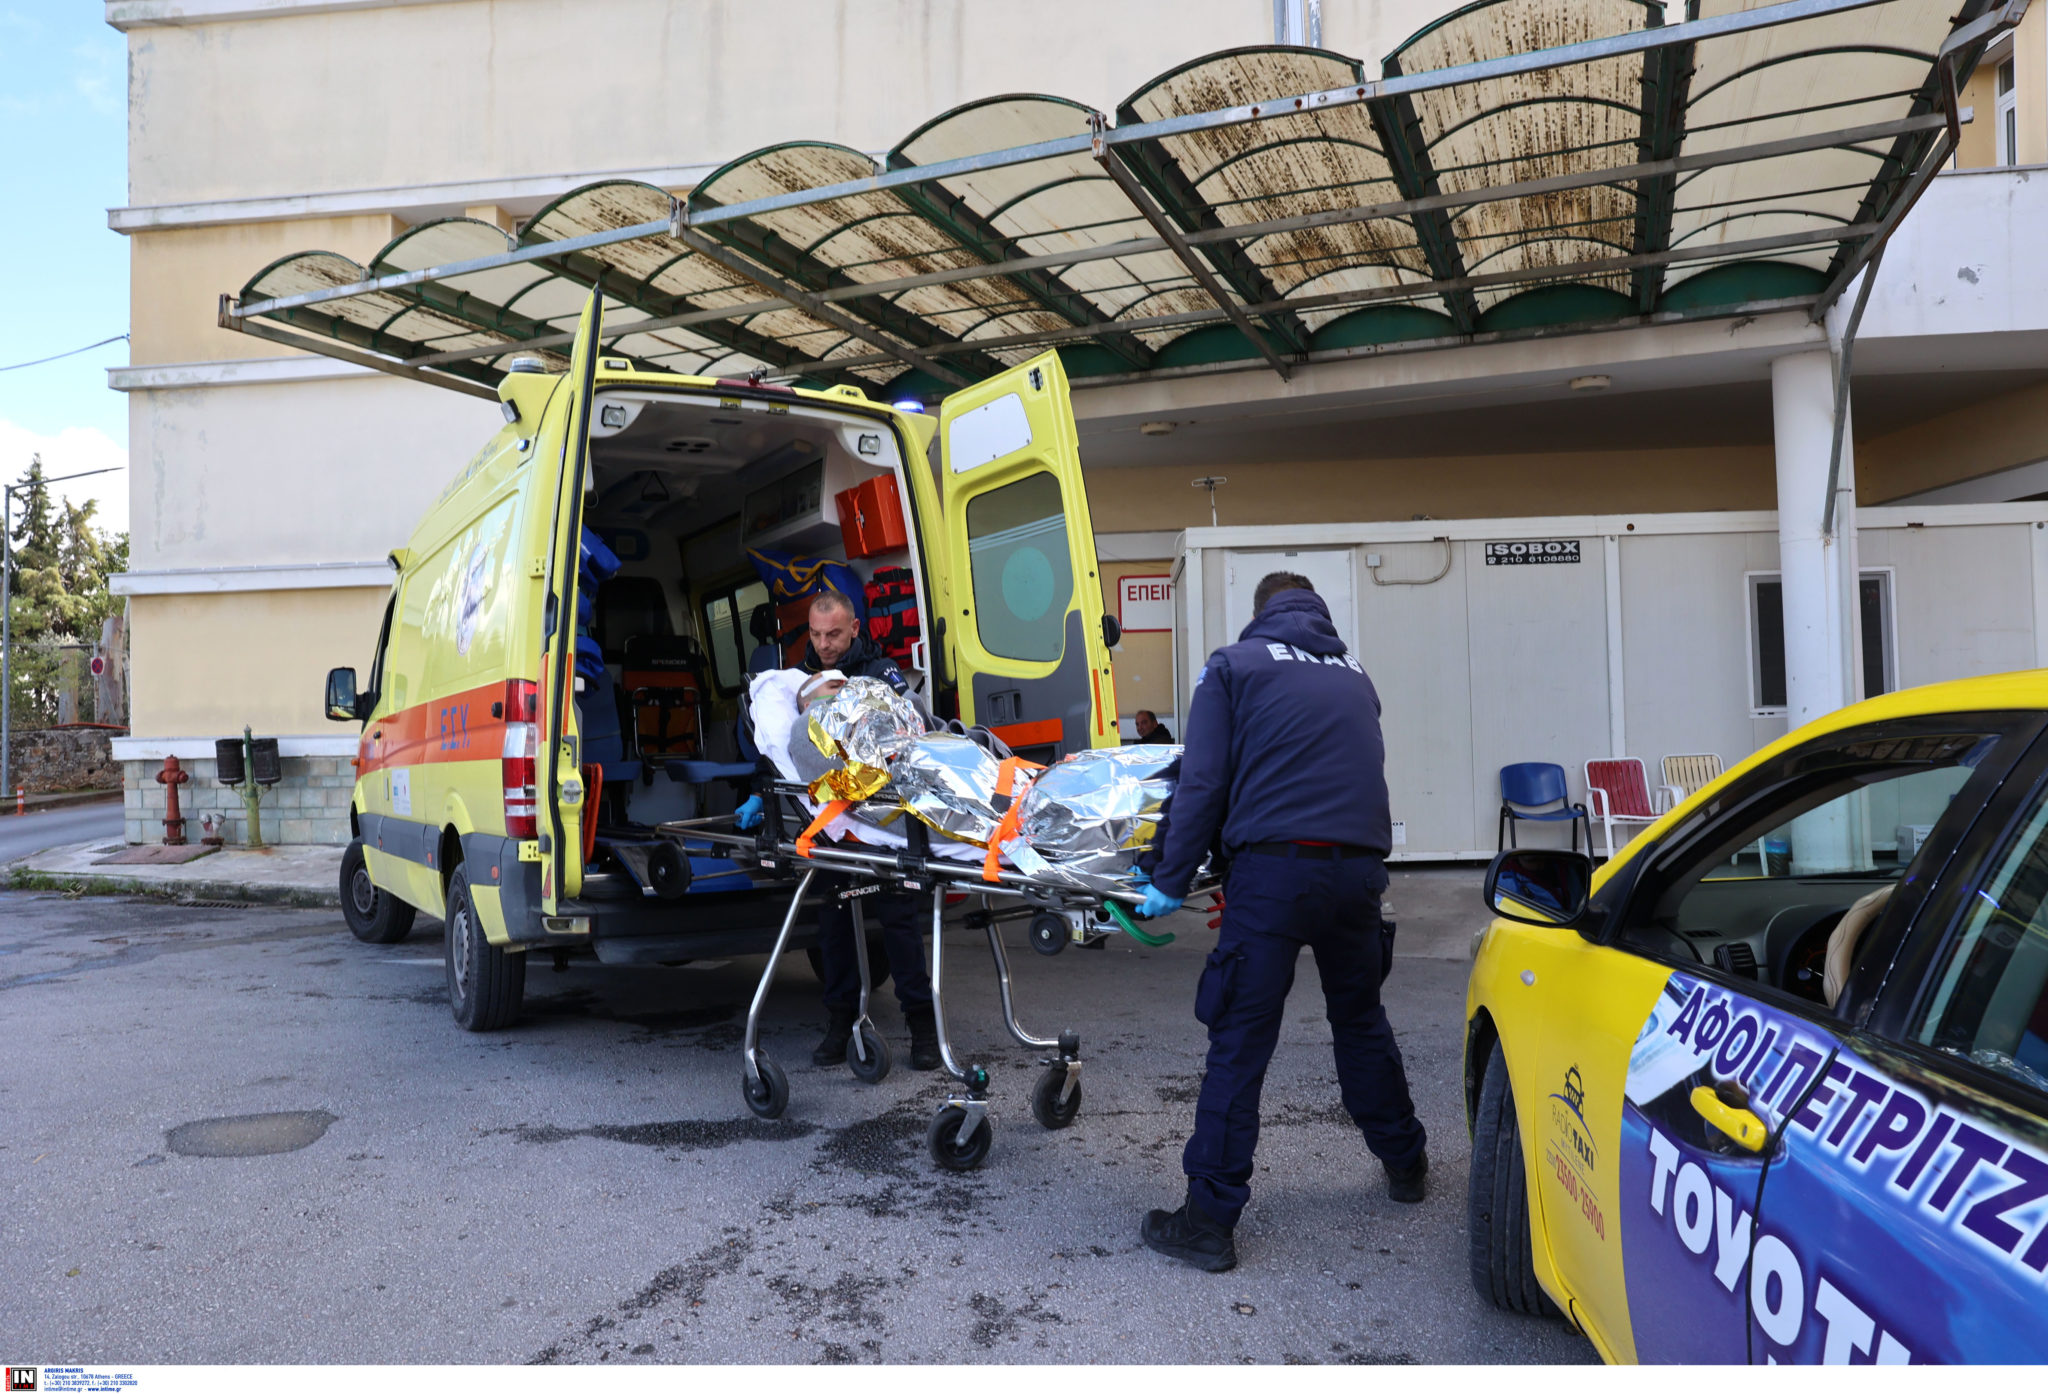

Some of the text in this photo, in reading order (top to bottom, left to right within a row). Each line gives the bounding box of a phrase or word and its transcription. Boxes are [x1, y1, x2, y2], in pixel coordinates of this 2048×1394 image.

[1486, 542, 1578, 555] ISOBOX
[840, 885, 880, 899] SPENCER
[1759, 1041, 2048, 1273] ΠΕΤΡΙΤΖ
